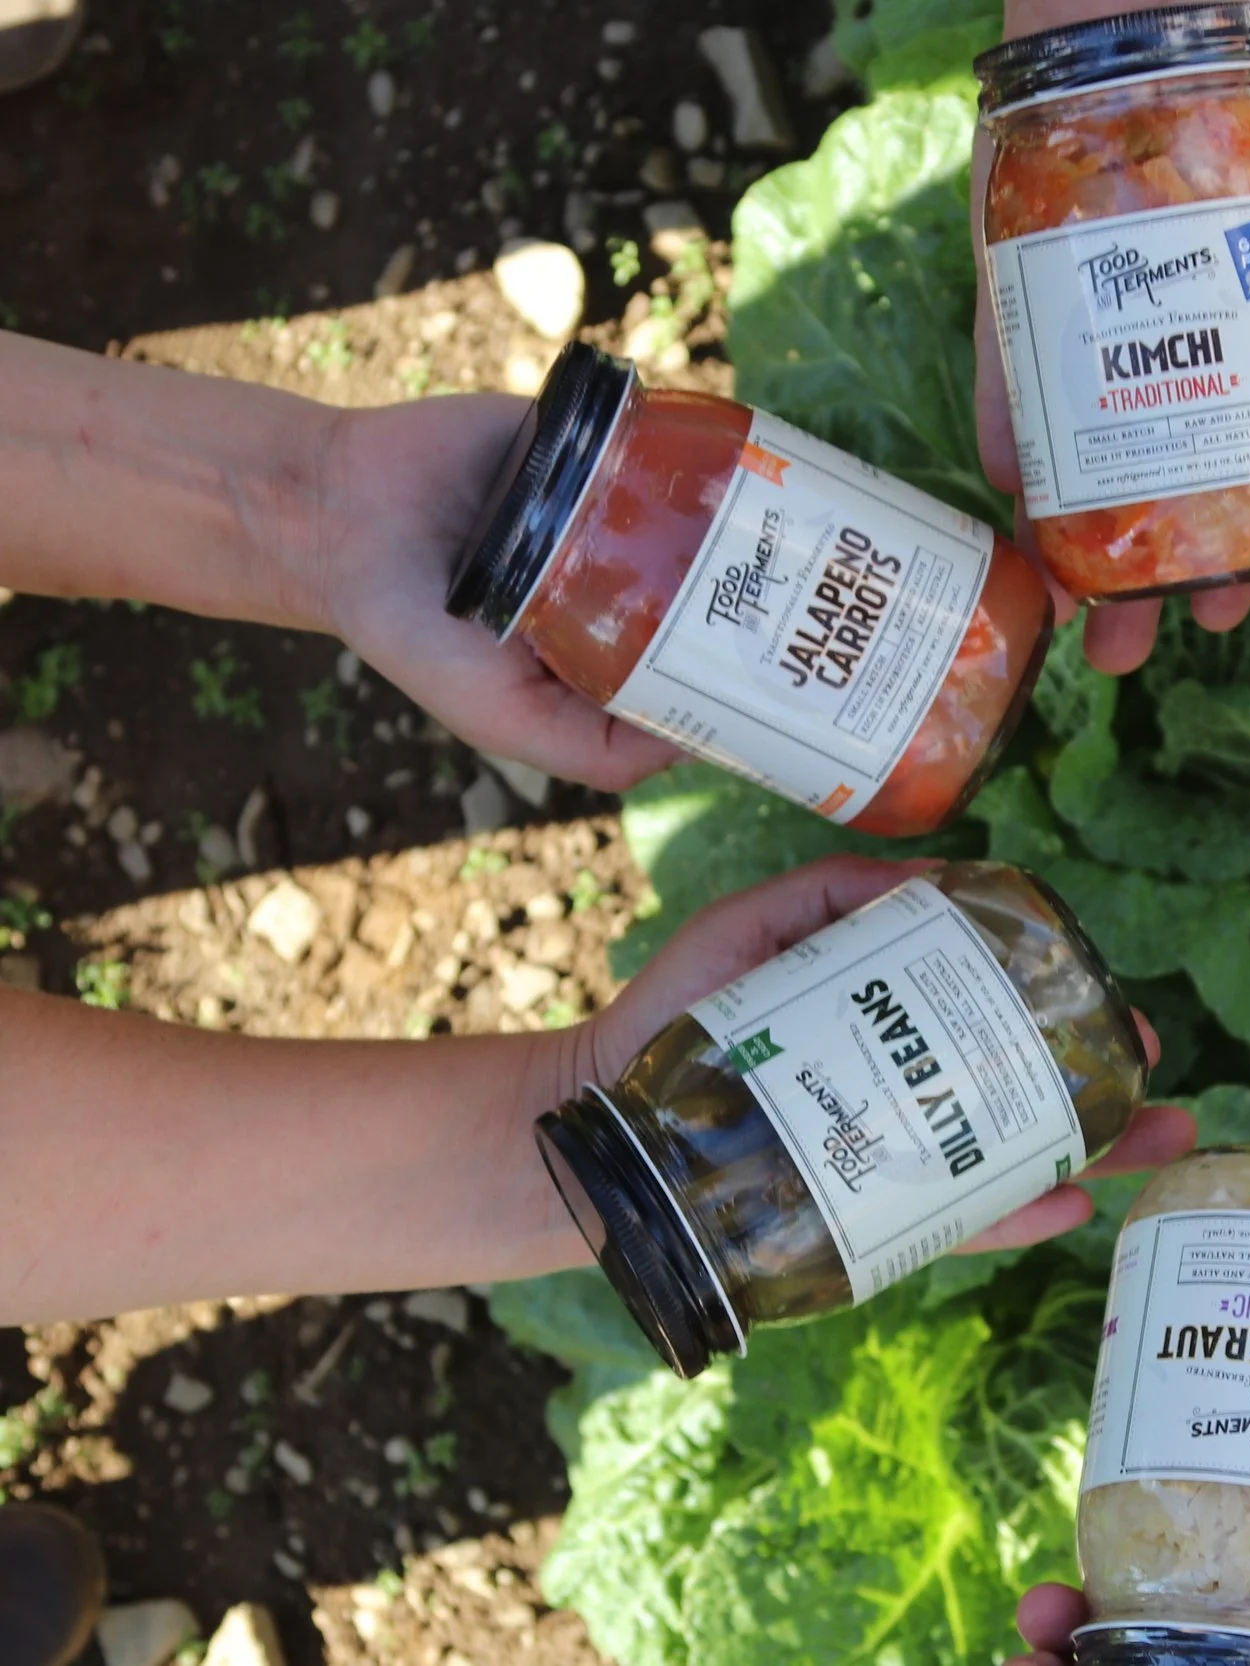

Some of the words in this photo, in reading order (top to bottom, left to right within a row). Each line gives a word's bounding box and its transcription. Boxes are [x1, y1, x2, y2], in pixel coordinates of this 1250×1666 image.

[1077, 241, 1141, 294] FOOD
[1101, 246, 1212, 310] FERMENTS
[1100, 326, 1223, 383] KIMCHI
[1106, 371, 1230, 414] TRADITIONAL
[1184, 417, 1205, 429] RAW
[1209, 413, 1231, 424] AND
[1084, 453, 1107, 465] RICH
[1110, 450, 1122, 461] IN
[1125, 440, 1188, 459] PROBIOTICS
[1087, 432, 1117, 445] SMALL
[1121, 427, 1155, 439] BATCH
[1202, 434, 1221, 445] ALL
[735, 508, 789, 616] FERMENTS
[706, 563, 741, 626] FOOD
[777, 525, 872, 688] JALAPENO
[813, 547, 904, 690] CARROTS
[849, 974, 942, 1090] BEANS
[794, 1068, 884, 1163] FERMENTS
[914, 1086, 984, 1179] DILLY
[821, 1134, 877, 1192] FOOD
[1188, 1250, 1235, 1259] NATURAL
[1190, 1268, 1220, 1277] ALIVE
[1221, 1269, 1245, 1278] AND
